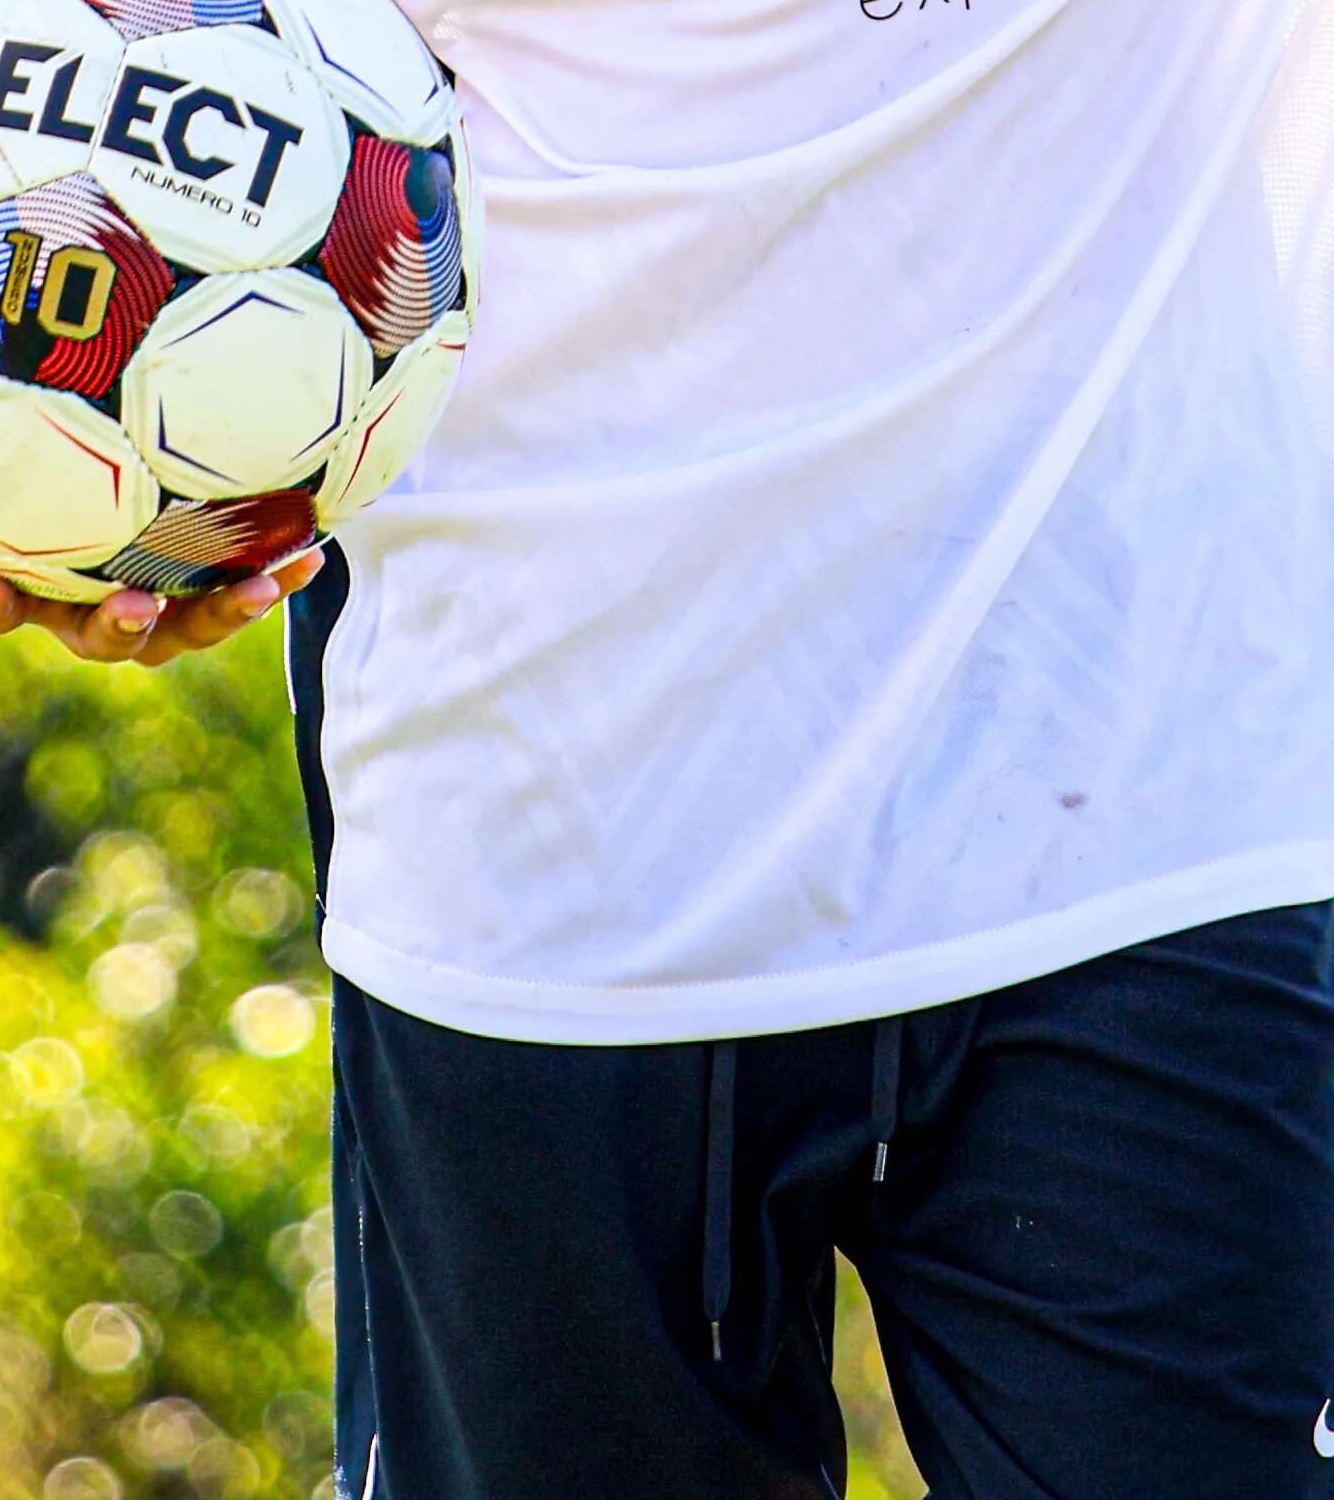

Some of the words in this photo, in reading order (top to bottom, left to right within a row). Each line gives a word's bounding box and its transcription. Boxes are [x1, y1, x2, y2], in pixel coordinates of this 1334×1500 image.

[130, 165, 235, 215] NUMERO
[240, 206, 263, 229] 10
[0, 228, 117, 342] 10
